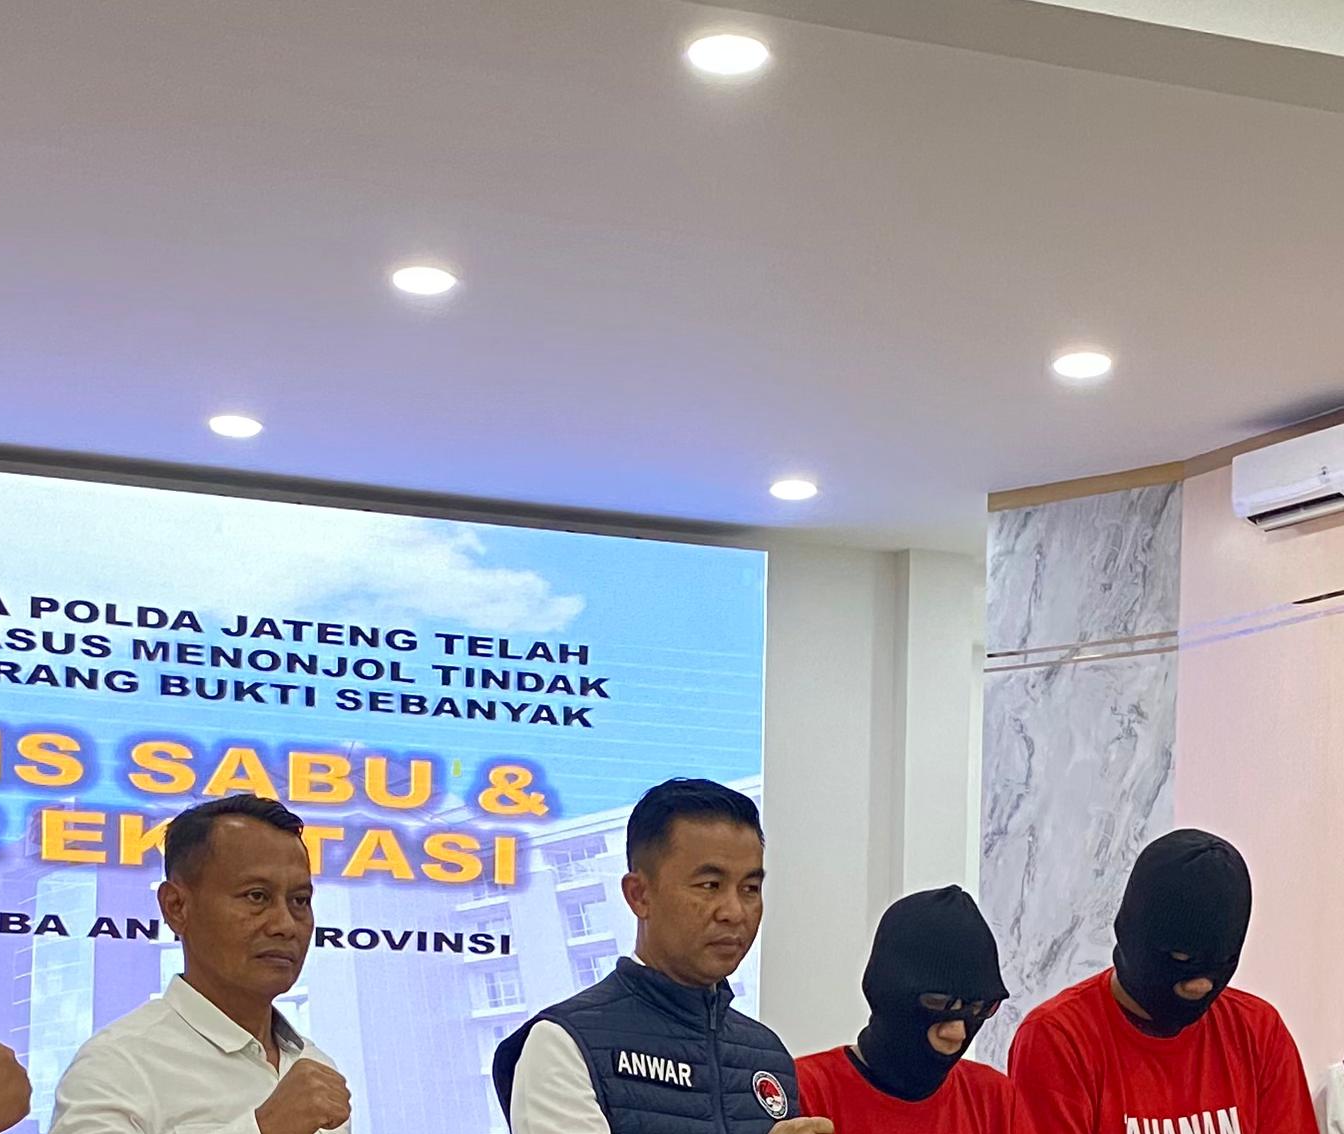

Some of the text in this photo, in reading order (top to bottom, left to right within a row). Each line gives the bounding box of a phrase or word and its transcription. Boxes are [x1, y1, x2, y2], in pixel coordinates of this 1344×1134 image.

[30, 596, 203, 633] POLDA
[220, 615, 417, 651] JATENG
[435, 633, 588, 666] TELAH
[133, 639, 415, 684] MENONJOL
[432, 665, 609, 698] TINDAK
[160, 674, 315, 707] BUKTI
[336, 688, 591, 728] SEBANYAK
[128, 741, 433, 810] SABU
[478, 765, 550, 816] &
[40, 808, 518, 886] EKTASI
[314, 926, 511, 955] ROVINSI
[618, 1050, 692, 1087] ANWAR
